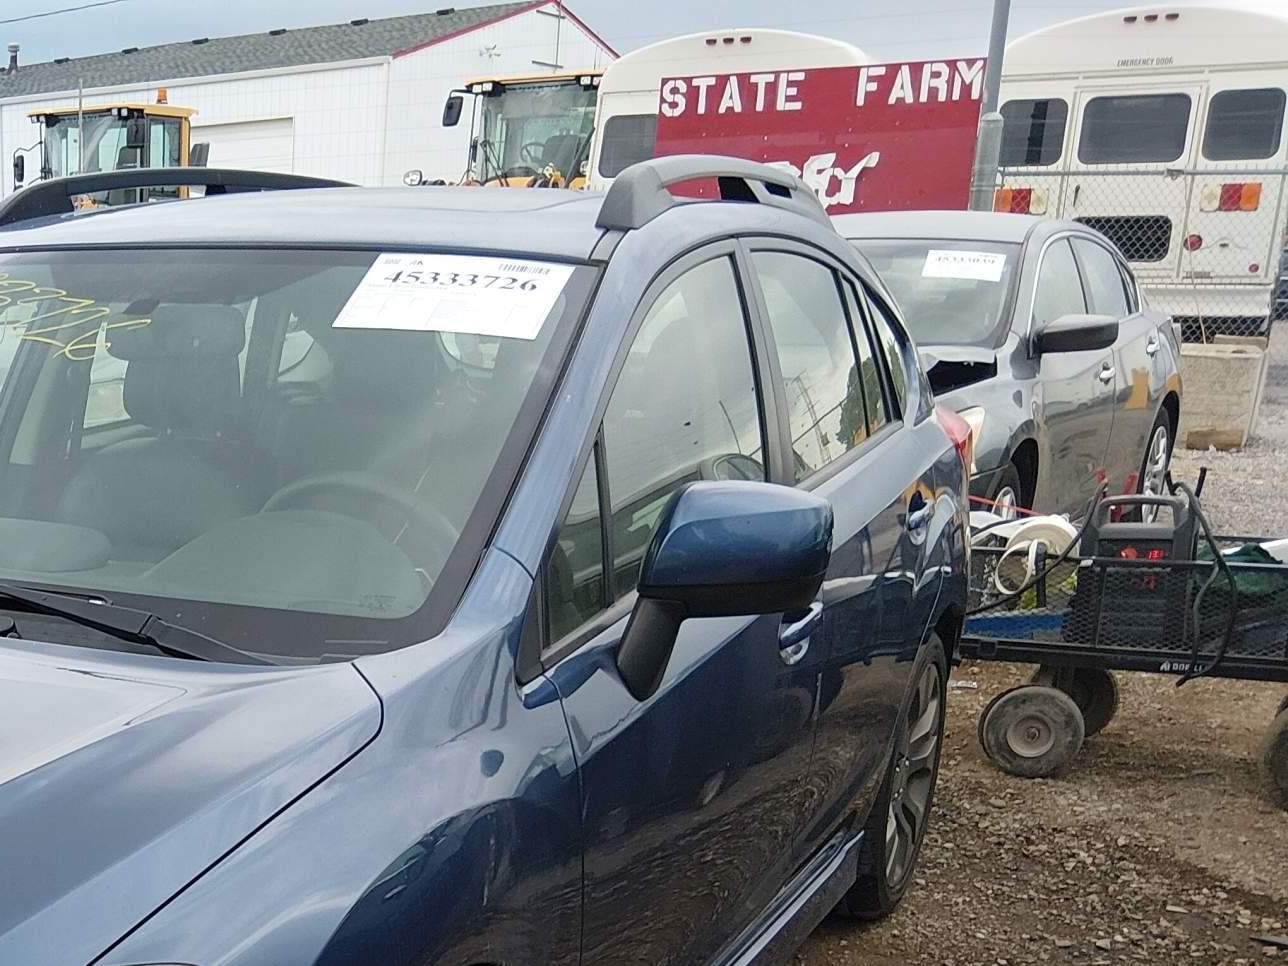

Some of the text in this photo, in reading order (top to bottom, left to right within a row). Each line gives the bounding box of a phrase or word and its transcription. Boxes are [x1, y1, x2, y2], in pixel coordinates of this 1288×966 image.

[660, 59, 984, 117] STATE FARM
[384, 270, 538, 291] 45333726
